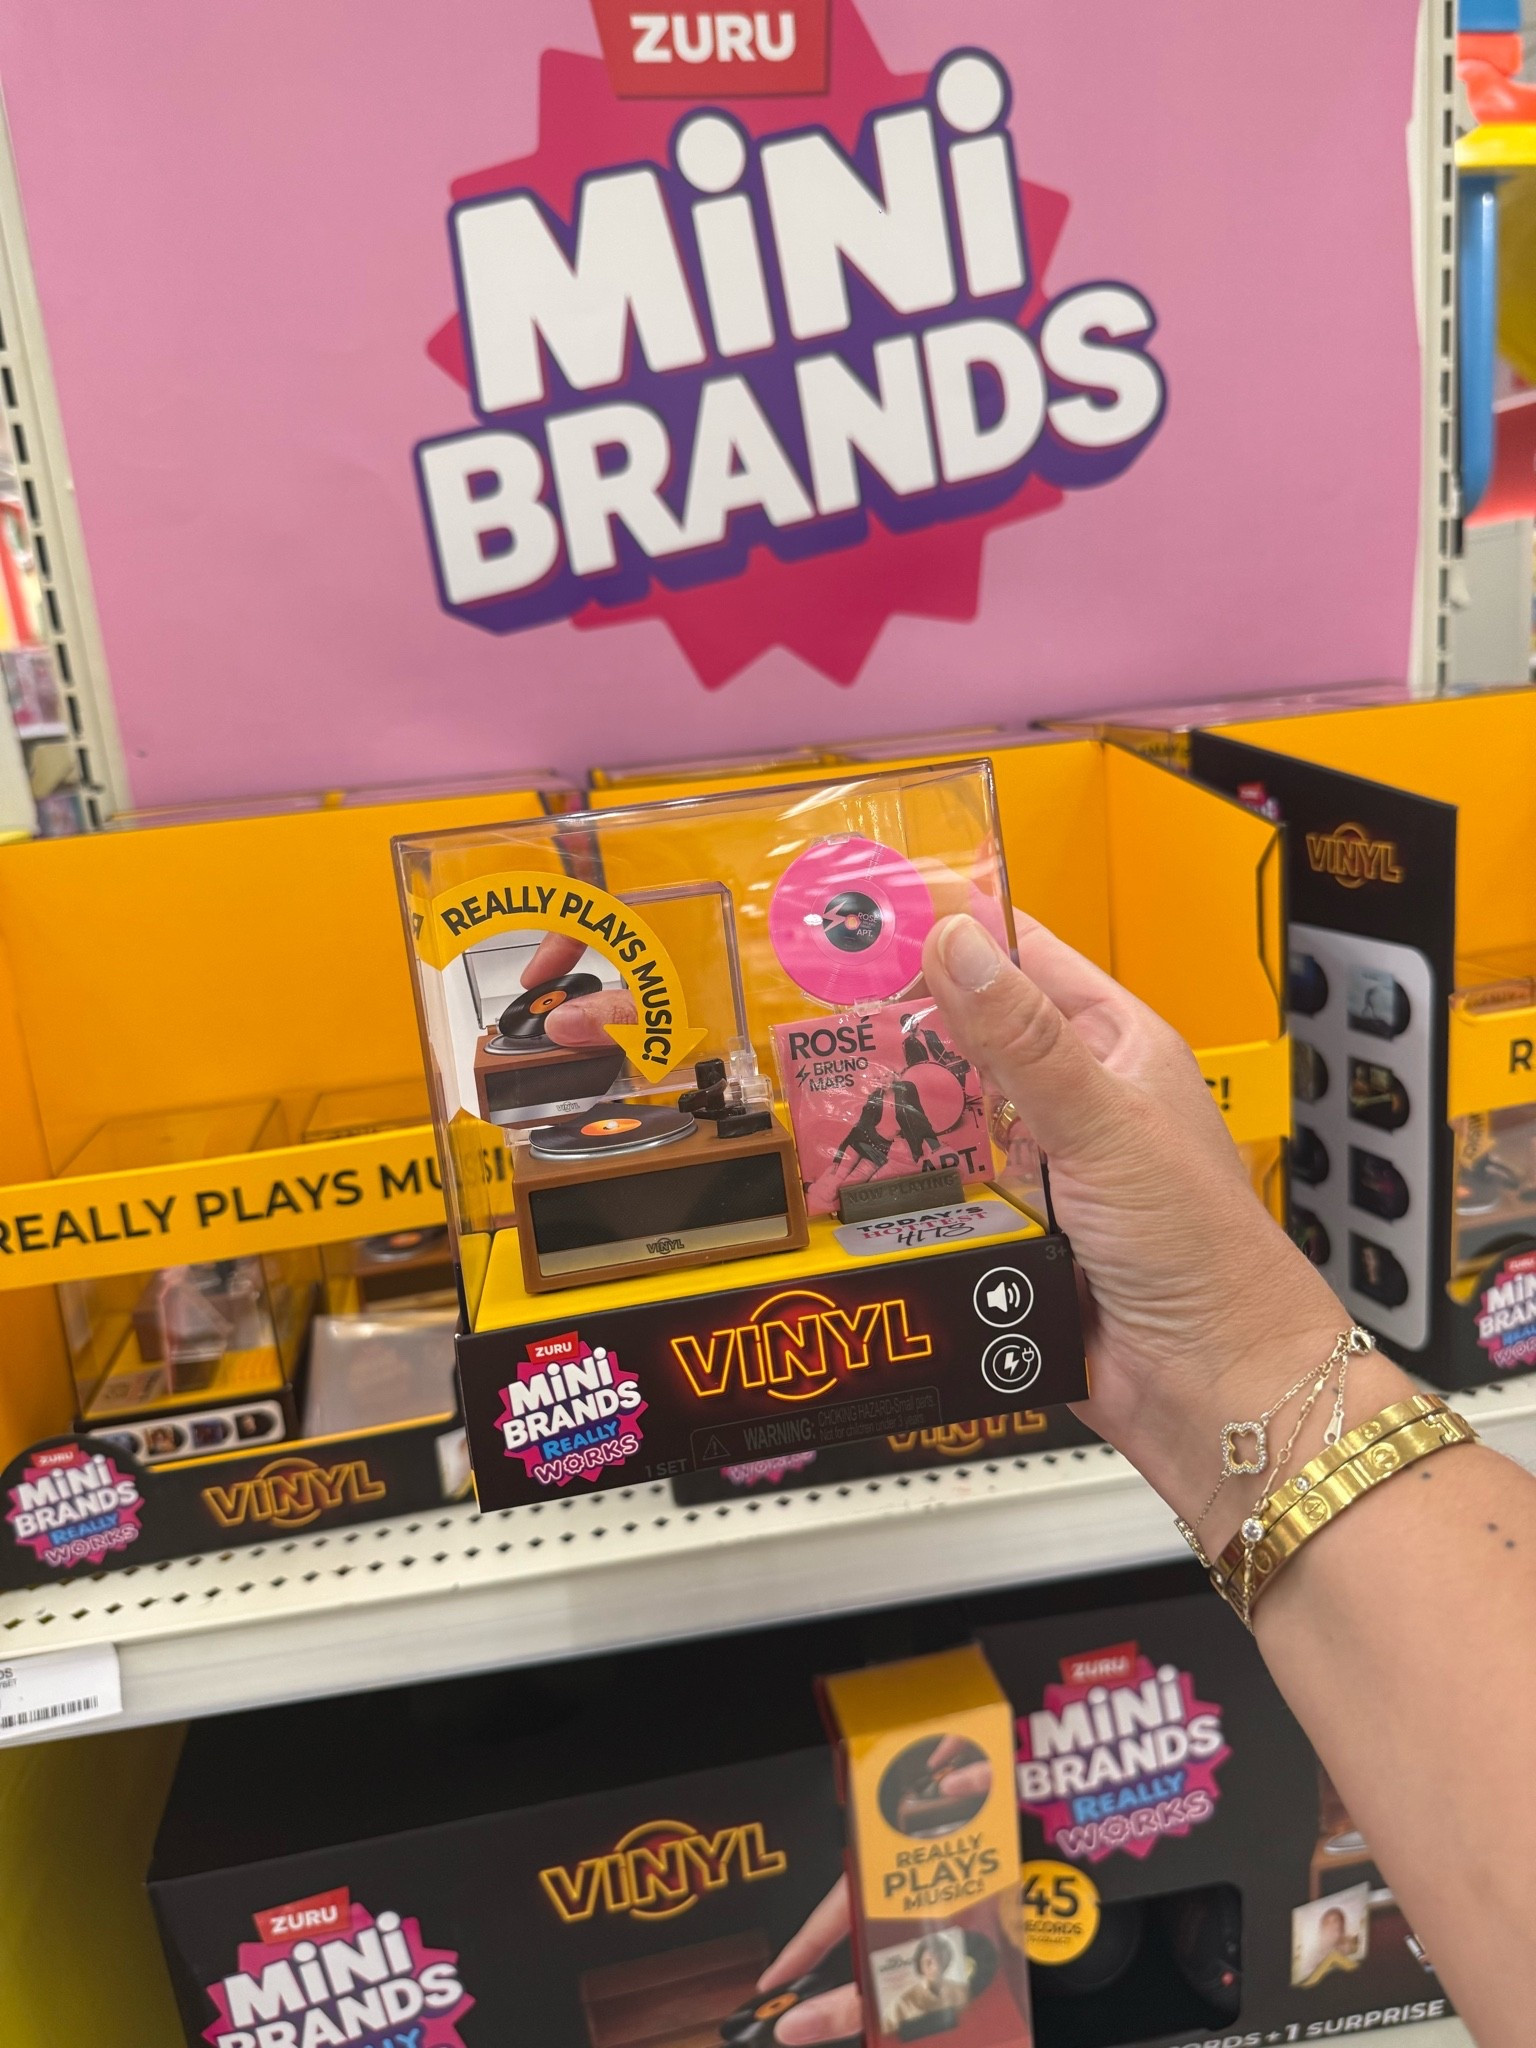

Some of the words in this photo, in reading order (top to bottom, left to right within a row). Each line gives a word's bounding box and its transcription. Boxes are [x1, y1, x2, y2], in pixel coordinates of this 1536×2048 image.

[629, 13, 797, 65] ZURU
[420, 287, 1165, 607] BRANDS
[1305, 831, 1404, 885] VINYL
[856, 928, 873, 938] APT.
[441, 885, 558, 937] REALLY
[559, 891, 647, 963] PLAYS
[631, 959, 673, 1066] MUSIC!
[788, 1015, 877, 1061] ROSÉ
[808, 1073, 855, 1093] MARS
[812, 1055, 869, 1077] BRUNO
[195, 1168, 364, 1229] PLAYS
[847, 1187, 883, 1205] NOW
[888, 1174, 955, 1196] PLAYING
[856, 1205, 984, 1233] TODAY'S
[863, 1211, 988, 1240] HOTTEST
[646, 1236, 685, 1255] VINYL
[1044, 1243, 1068, 1262] 3+
[534, 1341, 573, 1358] ZURU
[671, 1299, 933, 1399] VINYL
[502, 1380, 642, 1451] BRANDS
[743, 1417, 816, 1452] WARNING:
[816, 1404, 858, 1428] CHOKING
[533, 1433, 640, 1485] WORKS
[542, 1420, 619, 1460] REALLY
[656, 1457, 688, 1477] SET
[14, 1480, 140, 1538] BRANDS
[201, 1461, 387, 1527] VINYL
[44, 1523, 140, 1567] WORKS
[50, 1512, 119, 1546] REALLY
[1071, 1655, 1130, 1678] ZURU
[1017, 1713, 1225, 1803] BRANDS
[1071, 1770, 1186, 1824] REALLY
[1055, 1789, 1215, 1858] WORKS
[895, 1831, 983, 1869] REALLY
[538, 1822, 787, 1923] VINYL
[882, 1847, 1000, 1899] PLAYS
[902, 1878, 985, 1912] MUSIC!
[1022, 1874, 1080, 1918] 45
[269, 1904, 339, 1936] ZURU
[1305, 1998, 1447, 2037] SURPRISE
